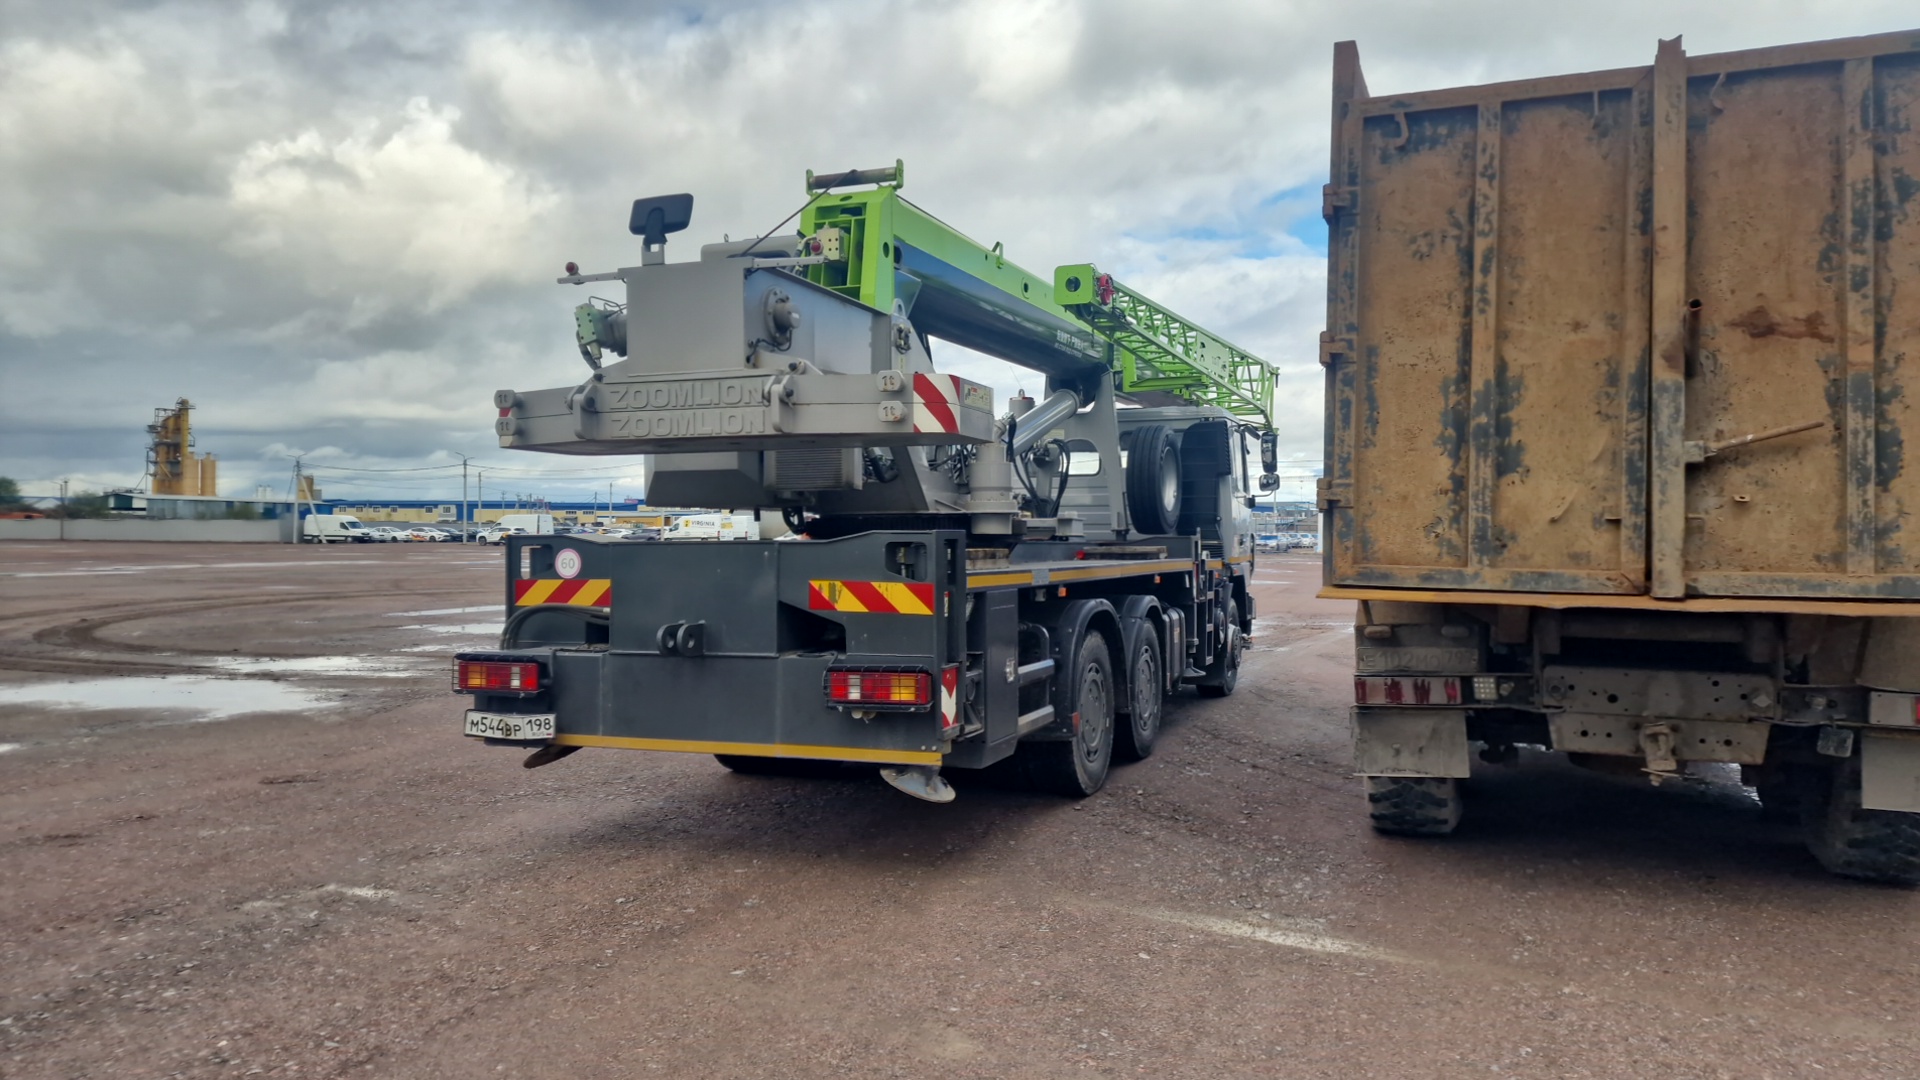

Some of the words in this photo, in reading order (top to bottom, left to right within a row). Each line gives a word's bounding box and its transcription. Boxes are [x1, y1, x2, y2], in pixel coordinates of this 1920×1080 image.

[609, 380, 765, 410] ZOOMLION
[610, 409, 766, 438] ZOOMLION
[561, 557, 575, 569] 60
[526, 718, 552, 732] 198
